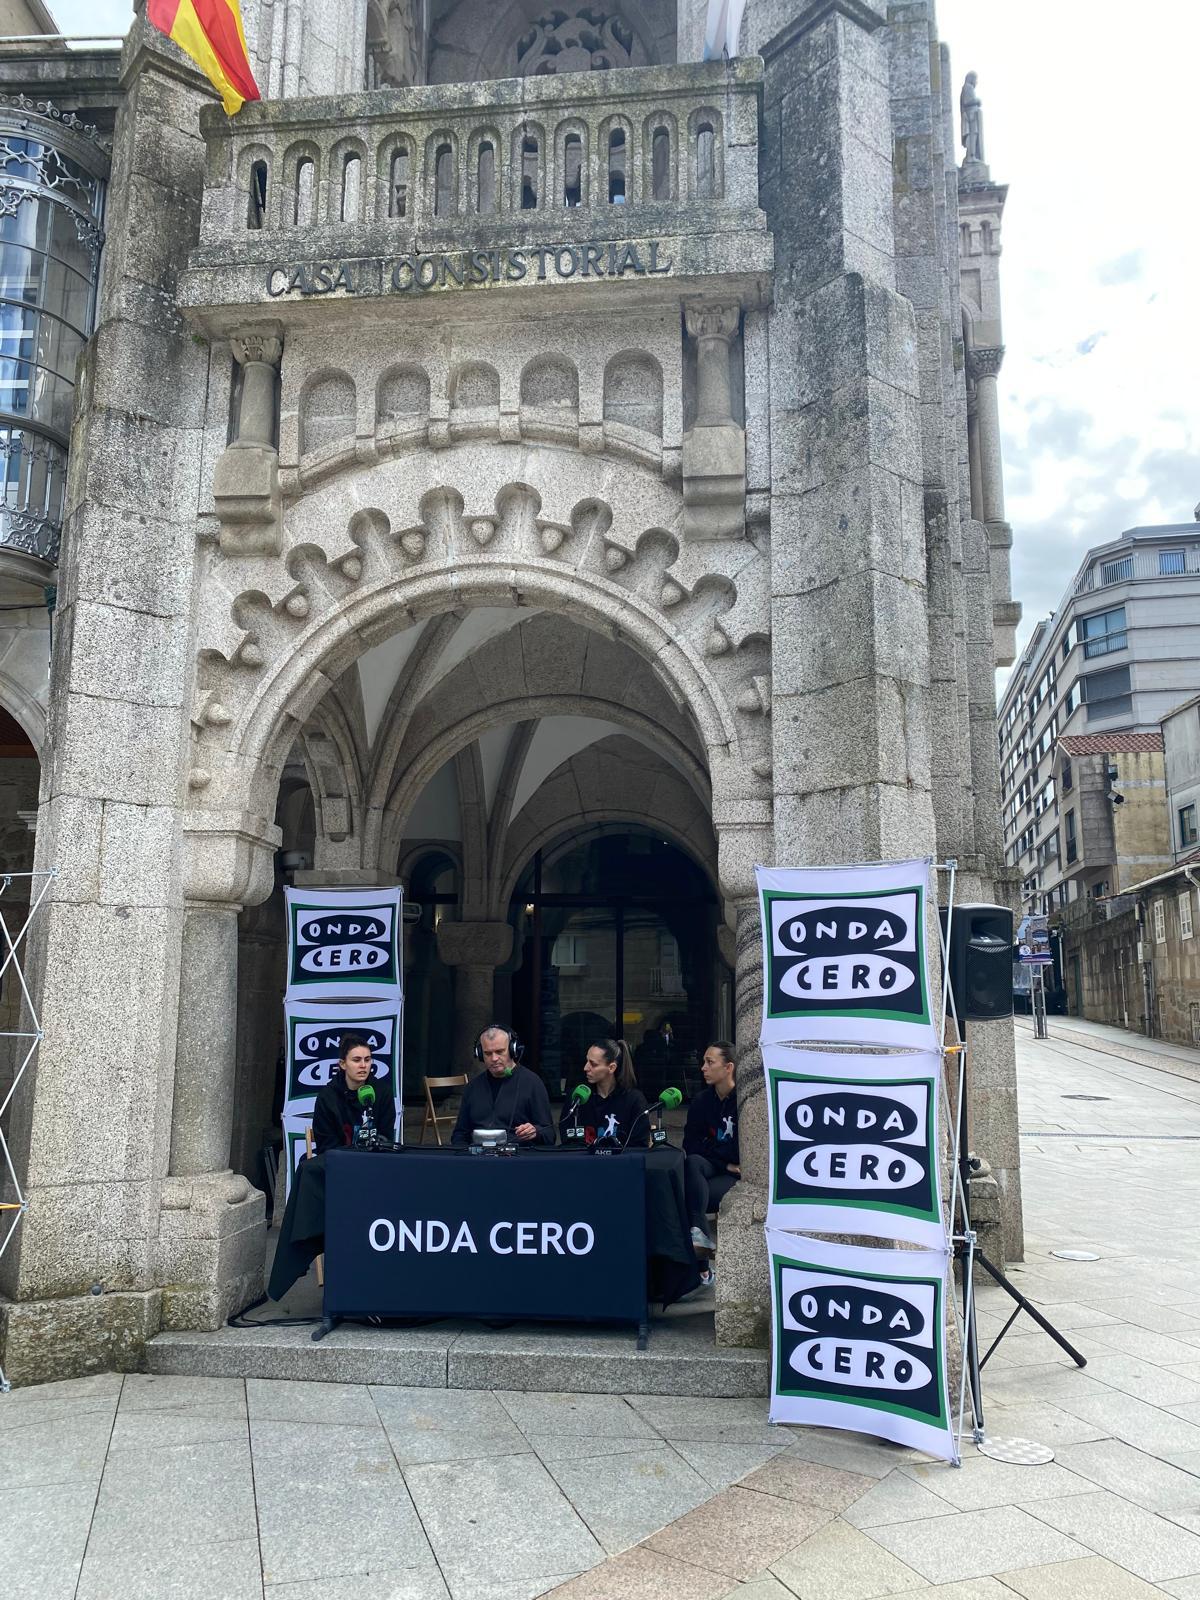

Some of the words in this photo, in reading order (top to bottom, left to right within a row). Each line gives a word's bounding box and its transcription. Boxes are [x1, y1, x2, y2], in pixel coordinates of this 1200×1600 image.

[266, 262, 355, 297] CASA
[391, 242, 673, 291] CONSISTORIAL
[309, 923, 378, 937] ONDA
[789, 920, 895, 943] ONDA
[312, 949, 379, 967] CERO
[796, 964, 898, 991] CERO
[307, 1035, 378, 1051] ONA
[796, 1104, 905, 1132] ONDA
[803, 1151, 906, 1183] CERO
[368, 1218, 478, 1254] ONDA
[489, 1221, 595, 1256] CERO
[800, 1294, 911, 1331] ONDA
[807, 1343, 913, 1384] CERO
